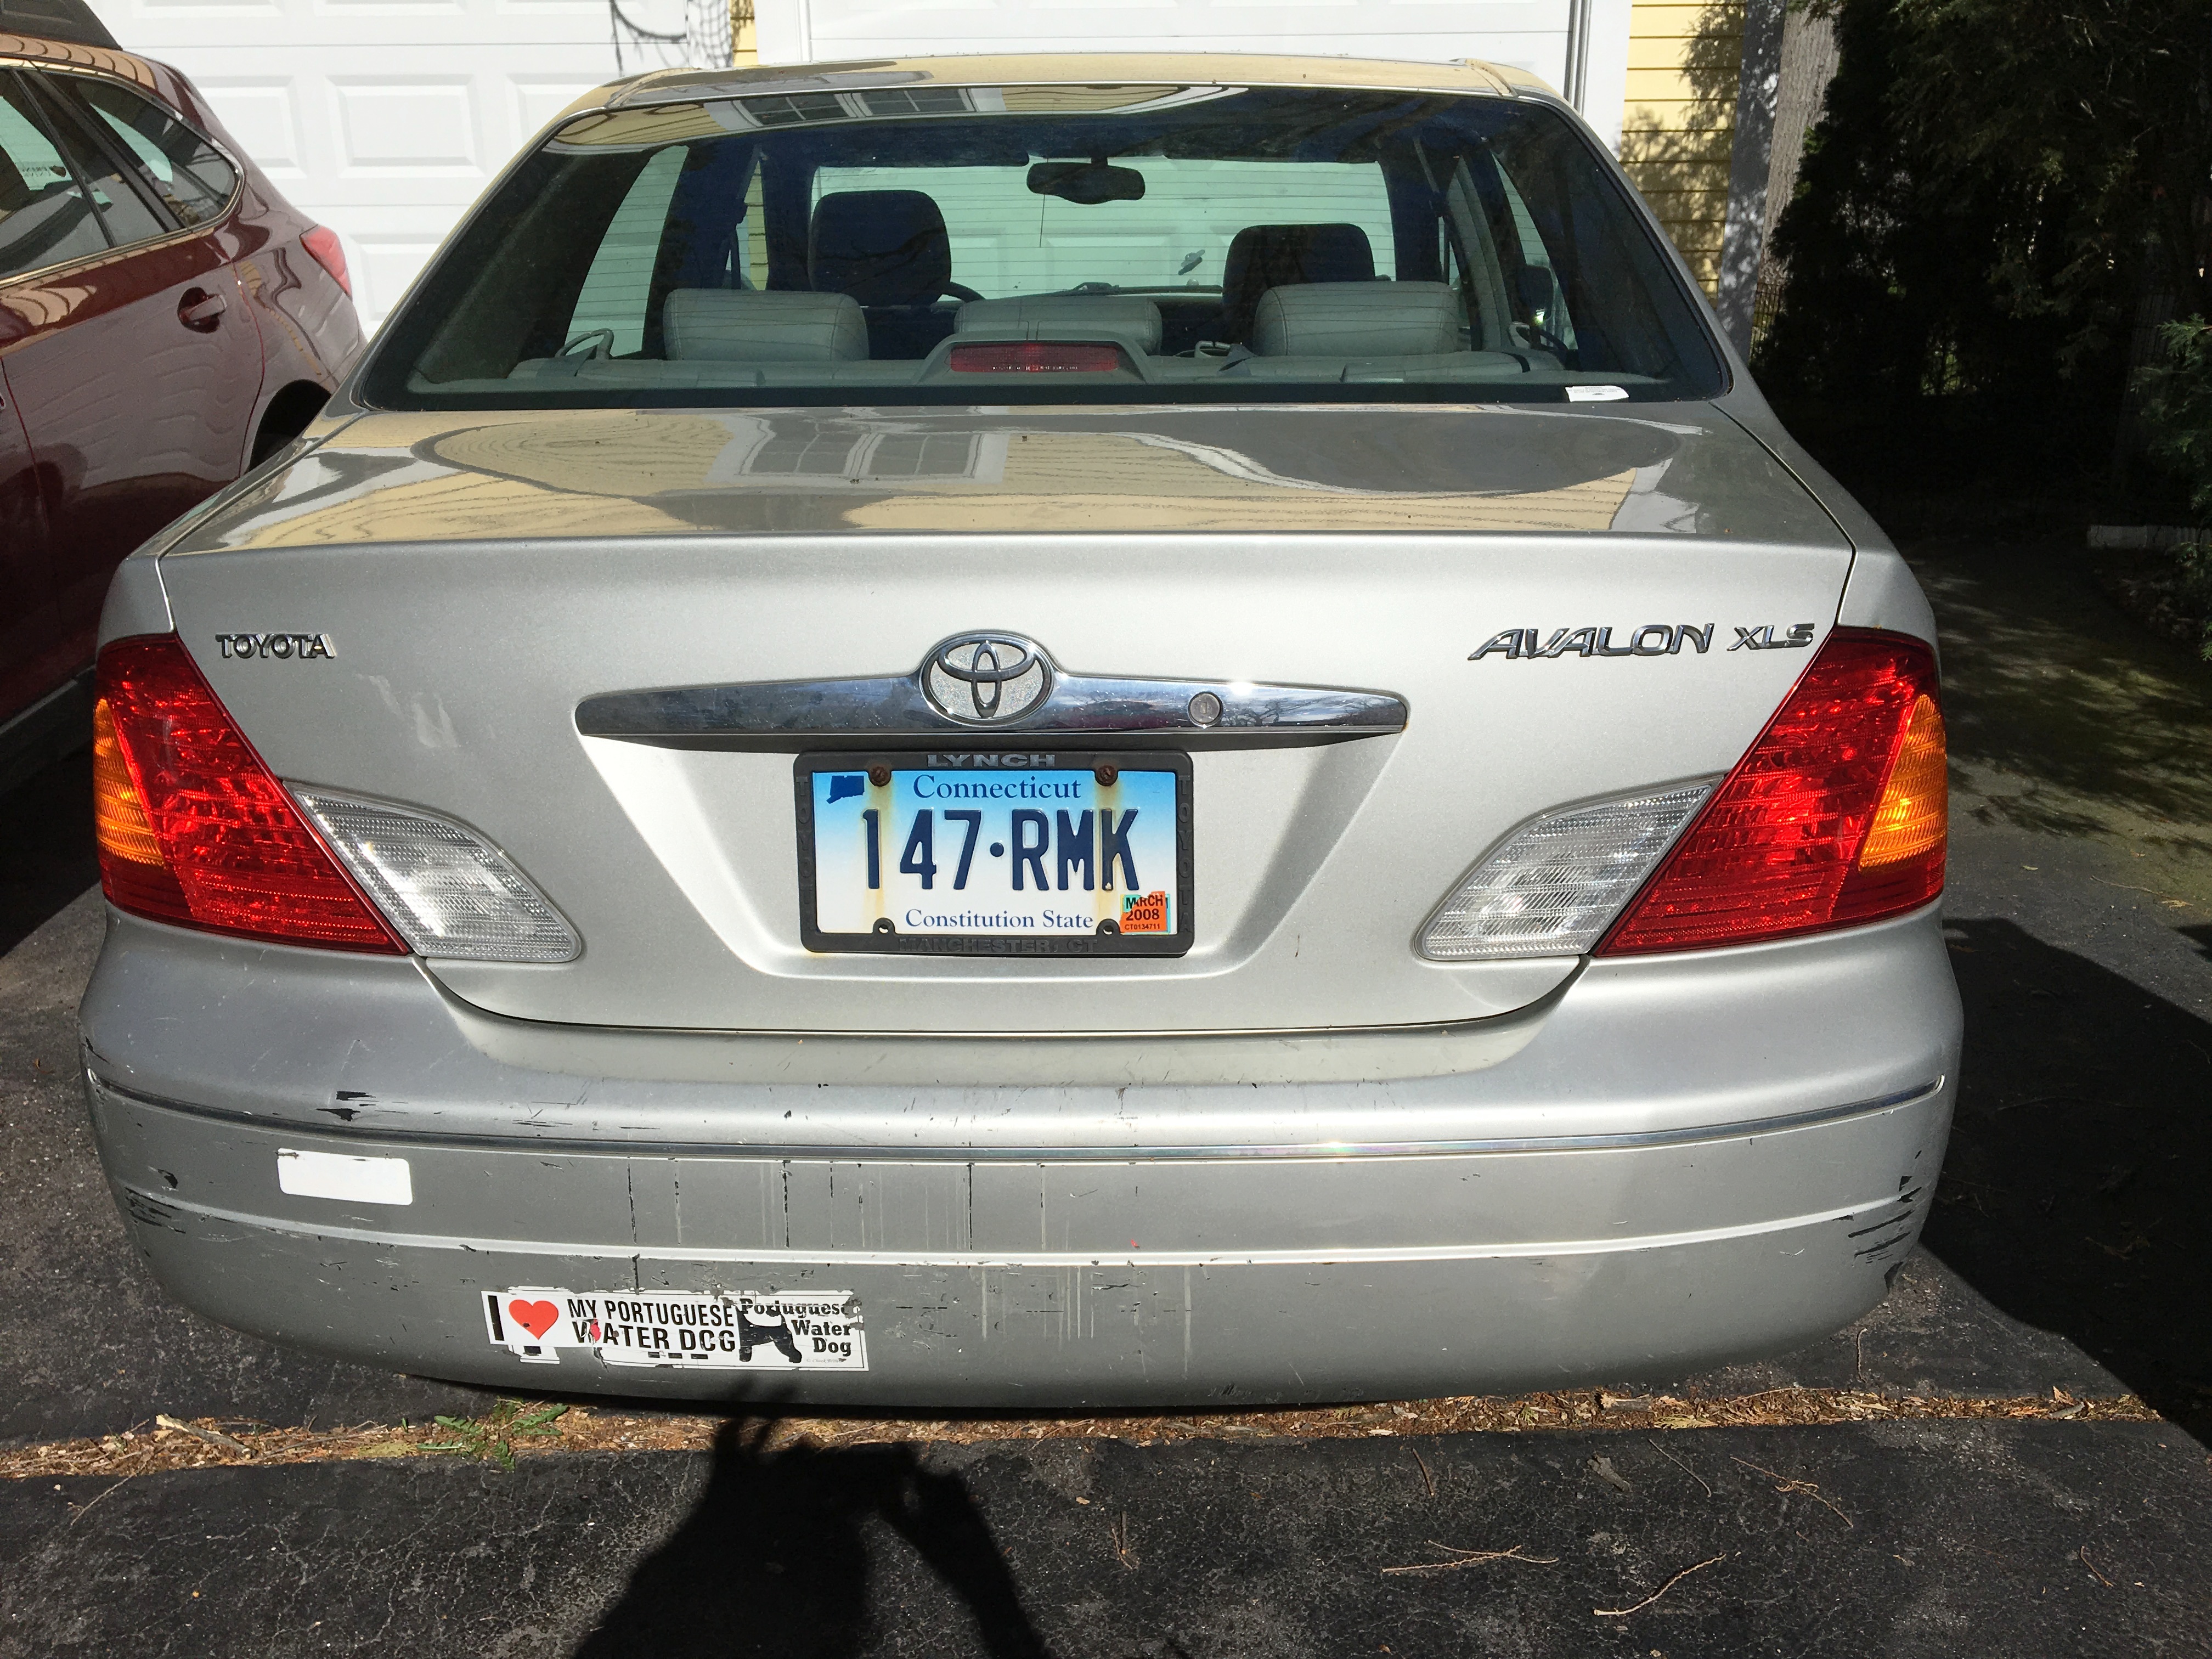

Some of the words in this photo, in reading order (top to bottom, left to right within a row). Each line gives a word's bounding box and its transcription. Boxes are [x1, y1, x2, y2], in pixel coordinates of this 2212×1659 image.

[215, 633, 337, 659] TOYOTA
[1468, 623, 1714, 660] AVALON
[1726, 623, 1815, 651] XLS
[927, 754, 1055, 767] LYNCH
[913, 774, 1081, 799] Connecticut
[1179, 775, 1193, 932] TOYOTA
[905, 909, 1035, 928] Constitution
[1043, 909, 1093, 929] State
[1126, 909, 1159, 921] 2008
[899, 938, 1058, 953] MANCHESTER,
[1068, 939, 1096, 952] CT
[488, 1295, 504, 1341] I
[567, 1299, 596, 1318] MY
[604, 1300, 734, 1327] PORTUGUESE
[791, 1319, 850, 1336] Water
[812, 1337, 851, 1357] Dog
